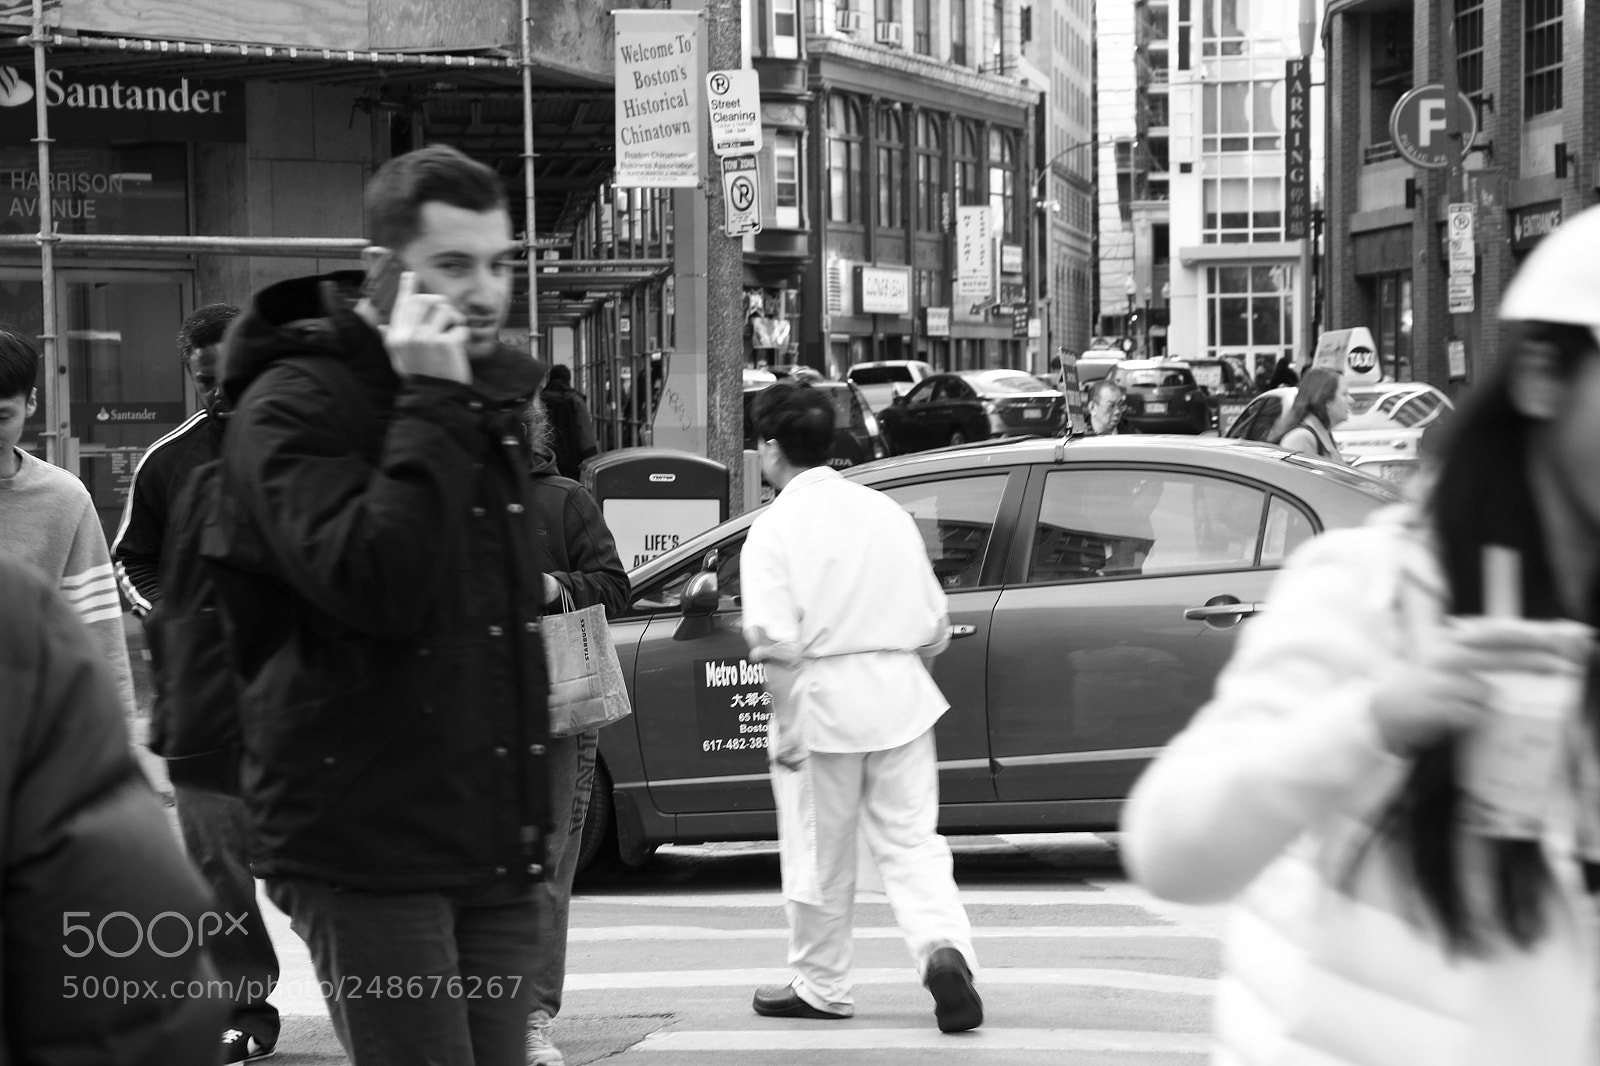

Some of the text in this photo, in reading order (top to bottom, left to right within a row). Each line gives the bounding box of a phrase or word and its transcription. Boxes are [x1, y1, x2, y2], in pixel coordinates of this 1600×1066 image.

[621, 34, 692, 64] Welcome To
[633, 64, 687, 89] Boston's
[45, 68, 226, 114] Santander
[623, 88, 689, 118] Historical
[711, 98, 741, 110] Street
[713, 111, 756, 123] Cleaning
[1290, 61, 1304, 183] PARKING
[621, 120, 691, 146] Chinatown
[1400, 133, 1429, 162] PUBLIC
[724, 158, 756, 170] TOW ZONE
[10, 170, 123, 193] HARRISON
[9, 197, 96, 218] AVNUE
[1523, 210, 1560, 237] ENTRANCE
[110, 408, 156, 420] Santander
[645, 534, 679, 551] LIFE'S
[580, 618, 590, 661] STARBUCKS
[705, 660, 738, 688] Metro
[738, 712, 751, 722] 65
